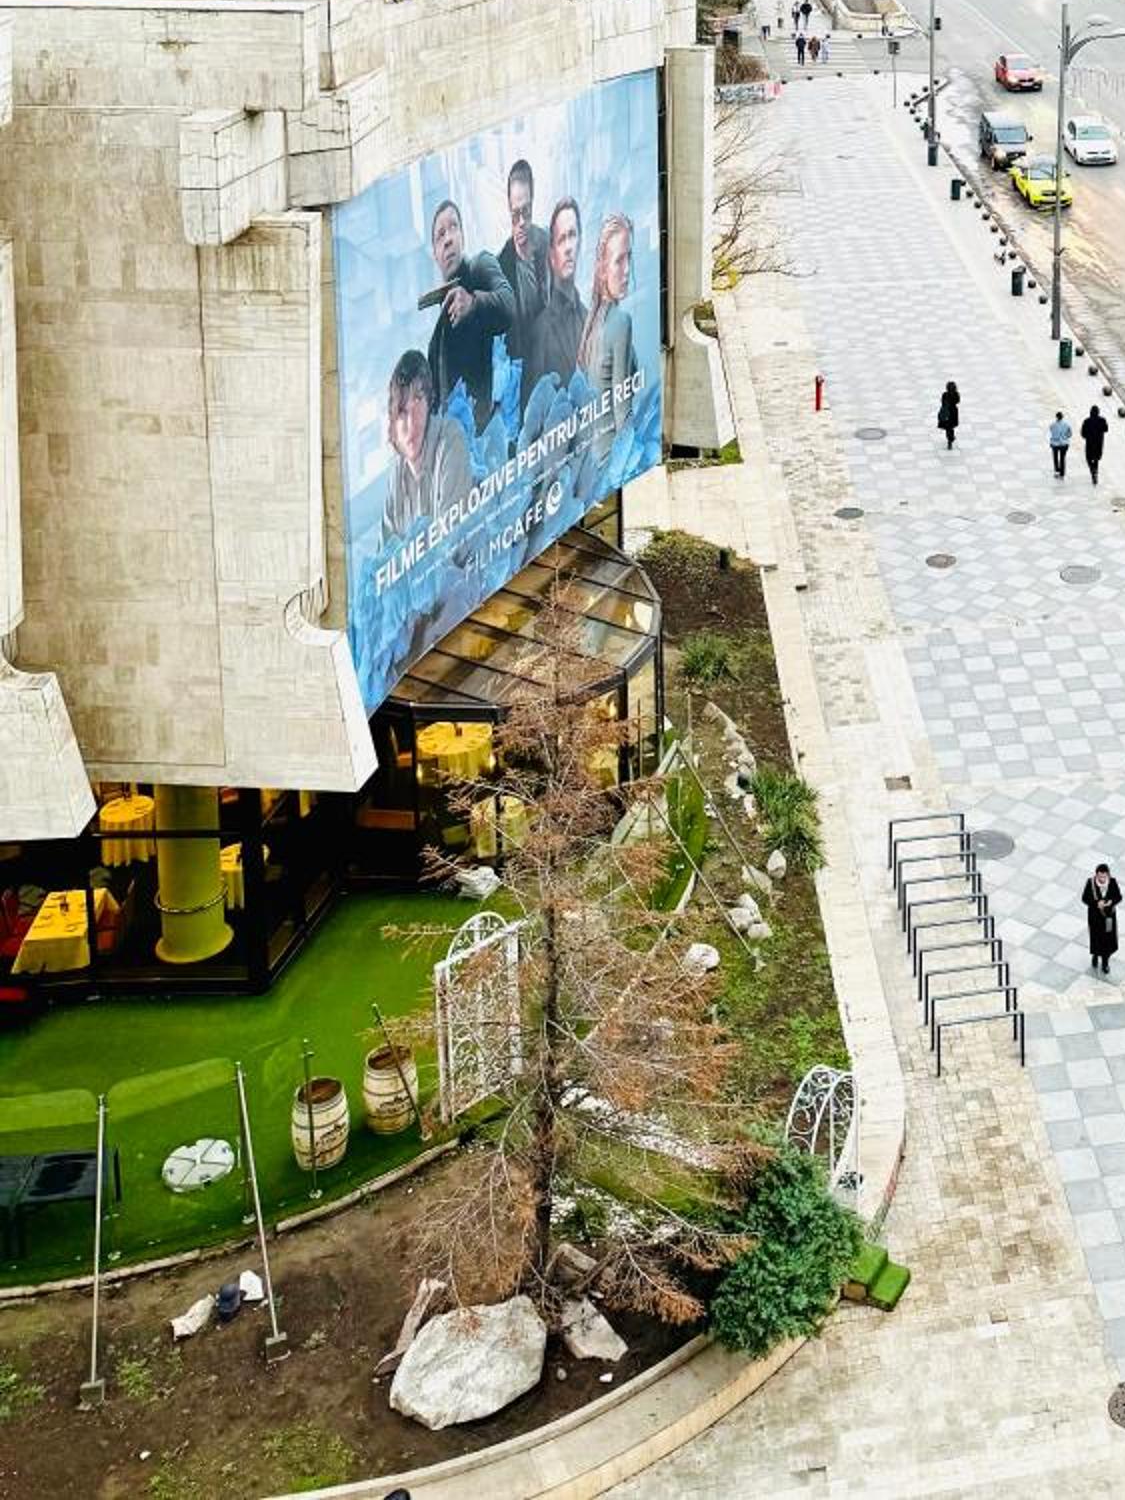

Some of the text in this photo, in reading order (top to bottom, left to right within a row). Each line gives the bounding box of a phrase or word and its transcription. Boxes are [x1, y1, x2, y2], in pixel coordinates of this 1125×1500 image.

[374, 370, 646, 596] FILME EXPLOZIVE PENTRU ZILE RECI
